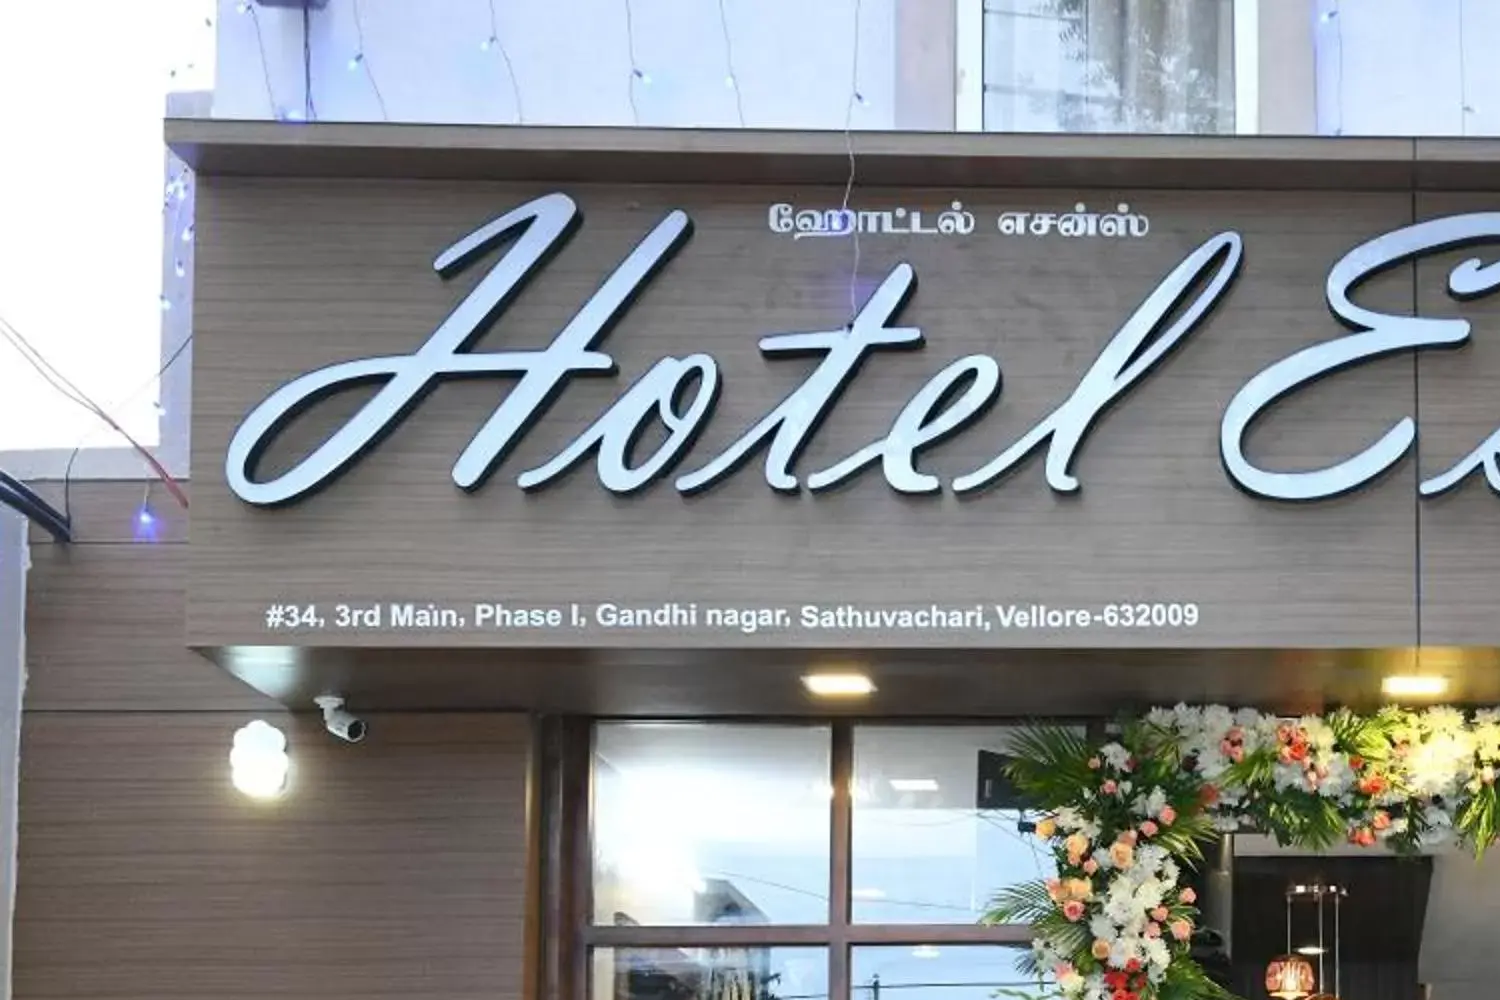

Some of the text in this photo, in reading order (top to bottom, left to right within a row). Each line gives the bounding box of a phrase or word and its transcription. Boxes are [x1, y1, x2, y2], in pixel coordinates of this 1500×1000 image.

[768, 202, 1149, 240] ஹோட்டல் எசன்ஸ்
[225, 192, 1244, 506] Hotel
[266, 604, 325, 628] #34,
[335, 604, 381, 627] 3rd
[390, 603, 465, 628] Main,
[475, 603, 562, 627] Phase
[595, 603, 697, 627] Gandhi
[706, 608, 791, 633] nagar,
[800, 604, 991, 632] Sathuvachari,
[995, 604, 1199, 628] Vellore-632009
